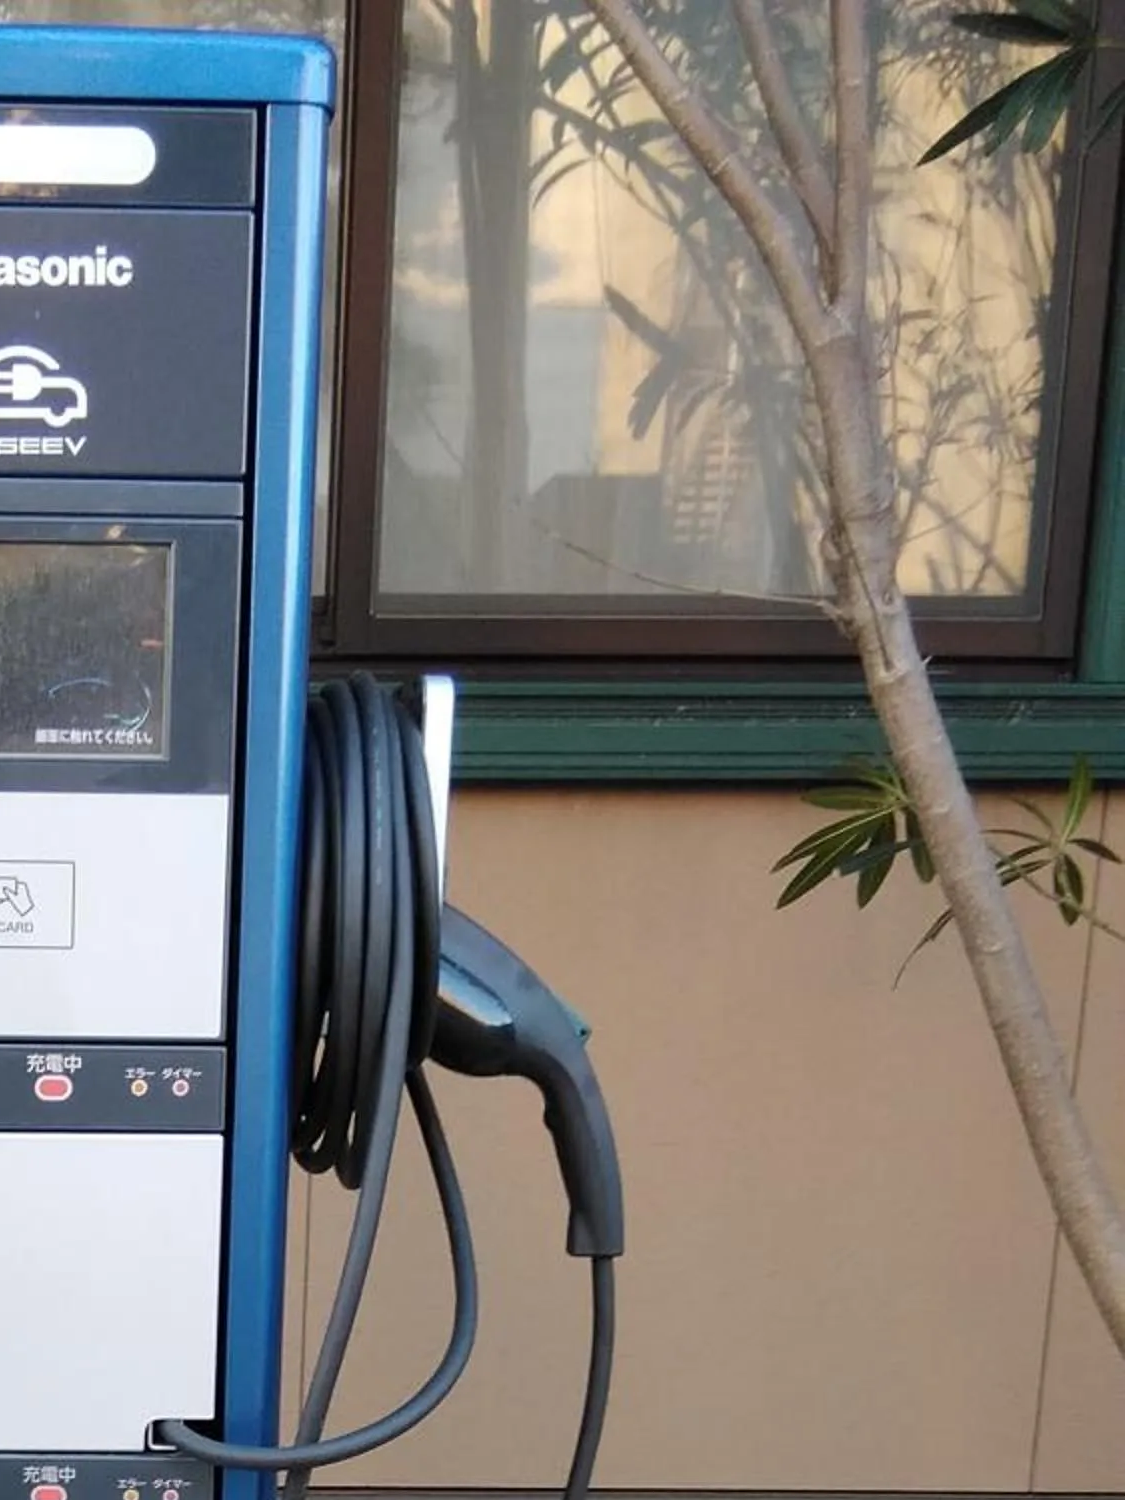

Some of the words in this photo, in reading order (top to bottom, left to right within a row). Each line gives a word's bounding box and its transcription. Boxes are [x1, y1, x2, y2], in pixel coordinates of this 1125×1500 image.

[26, 1054, 82, 1073] 充電中
[125, 1068, 156, 1079] エラー
[162, 1068, 202, 1079] タイマー
[23, 1466, 76, 1483] 充電中
